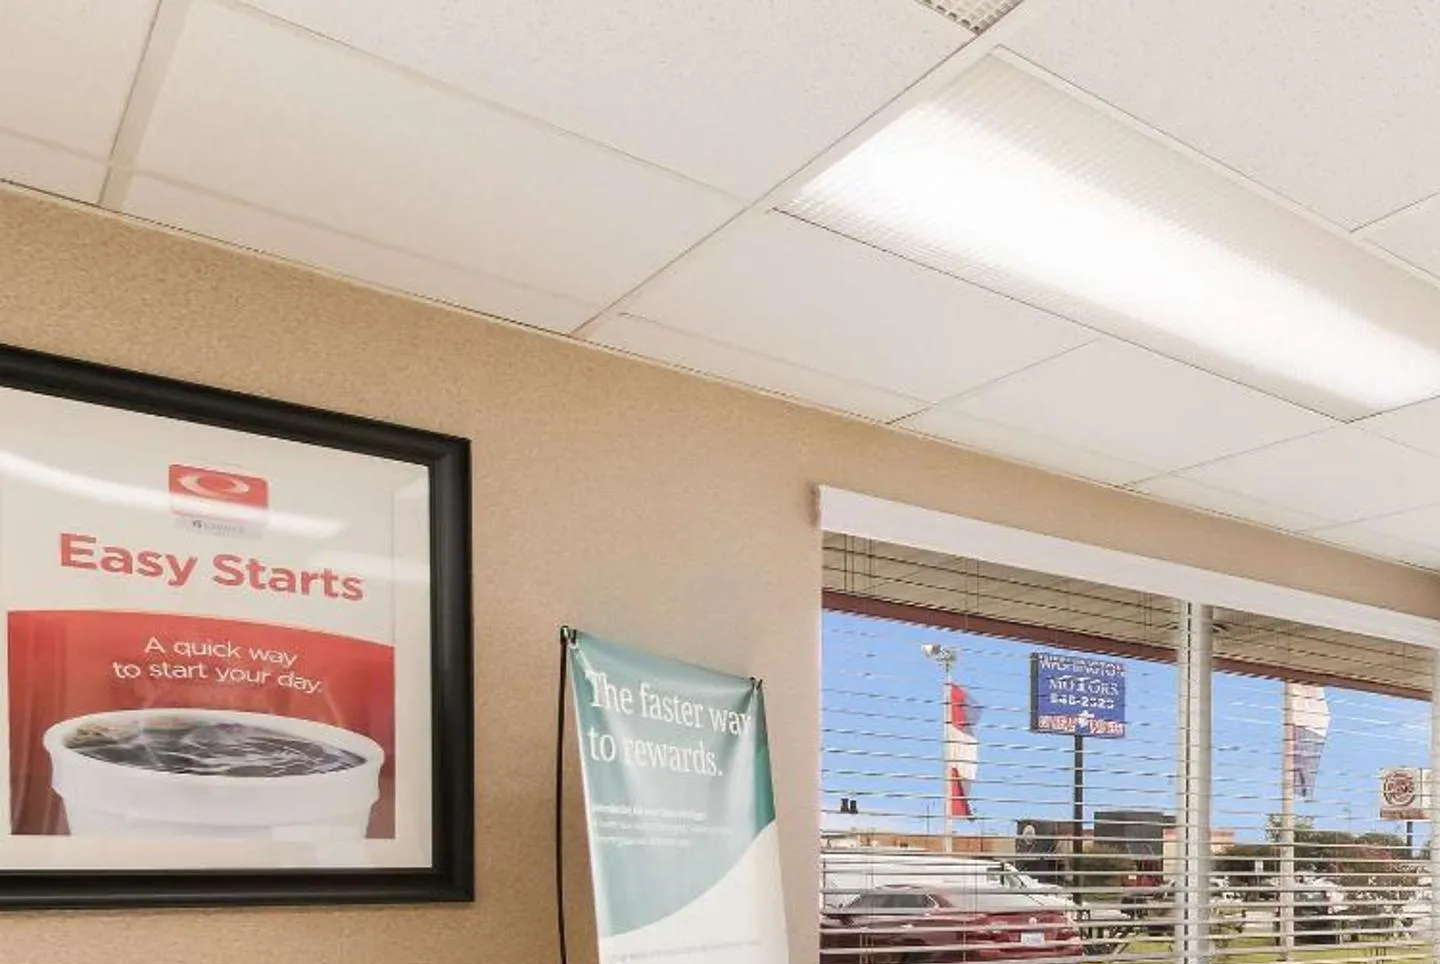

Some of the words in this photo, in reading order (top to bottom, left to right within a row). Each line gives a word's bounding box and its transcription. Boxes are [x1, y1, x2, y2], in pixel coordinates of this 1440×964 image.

[60, 533, 198, 586] Easy
[213, 553, 364, 601] Starts
[113, 662, 141, 679] to
[150, 662, 208, 679] start
[216, 667, 271, 685] your
[278, 669, 323, 693] day.
[144, 637, 165, 654] A
[173, 641, 242, 659] quick
[249, 649, 298, 667] way
[584, 669, 633, 715] The
[640, 682, 704, 728] faster
[587, 726, 616, 763] to
[623, 738, 724, 777] rewards.
